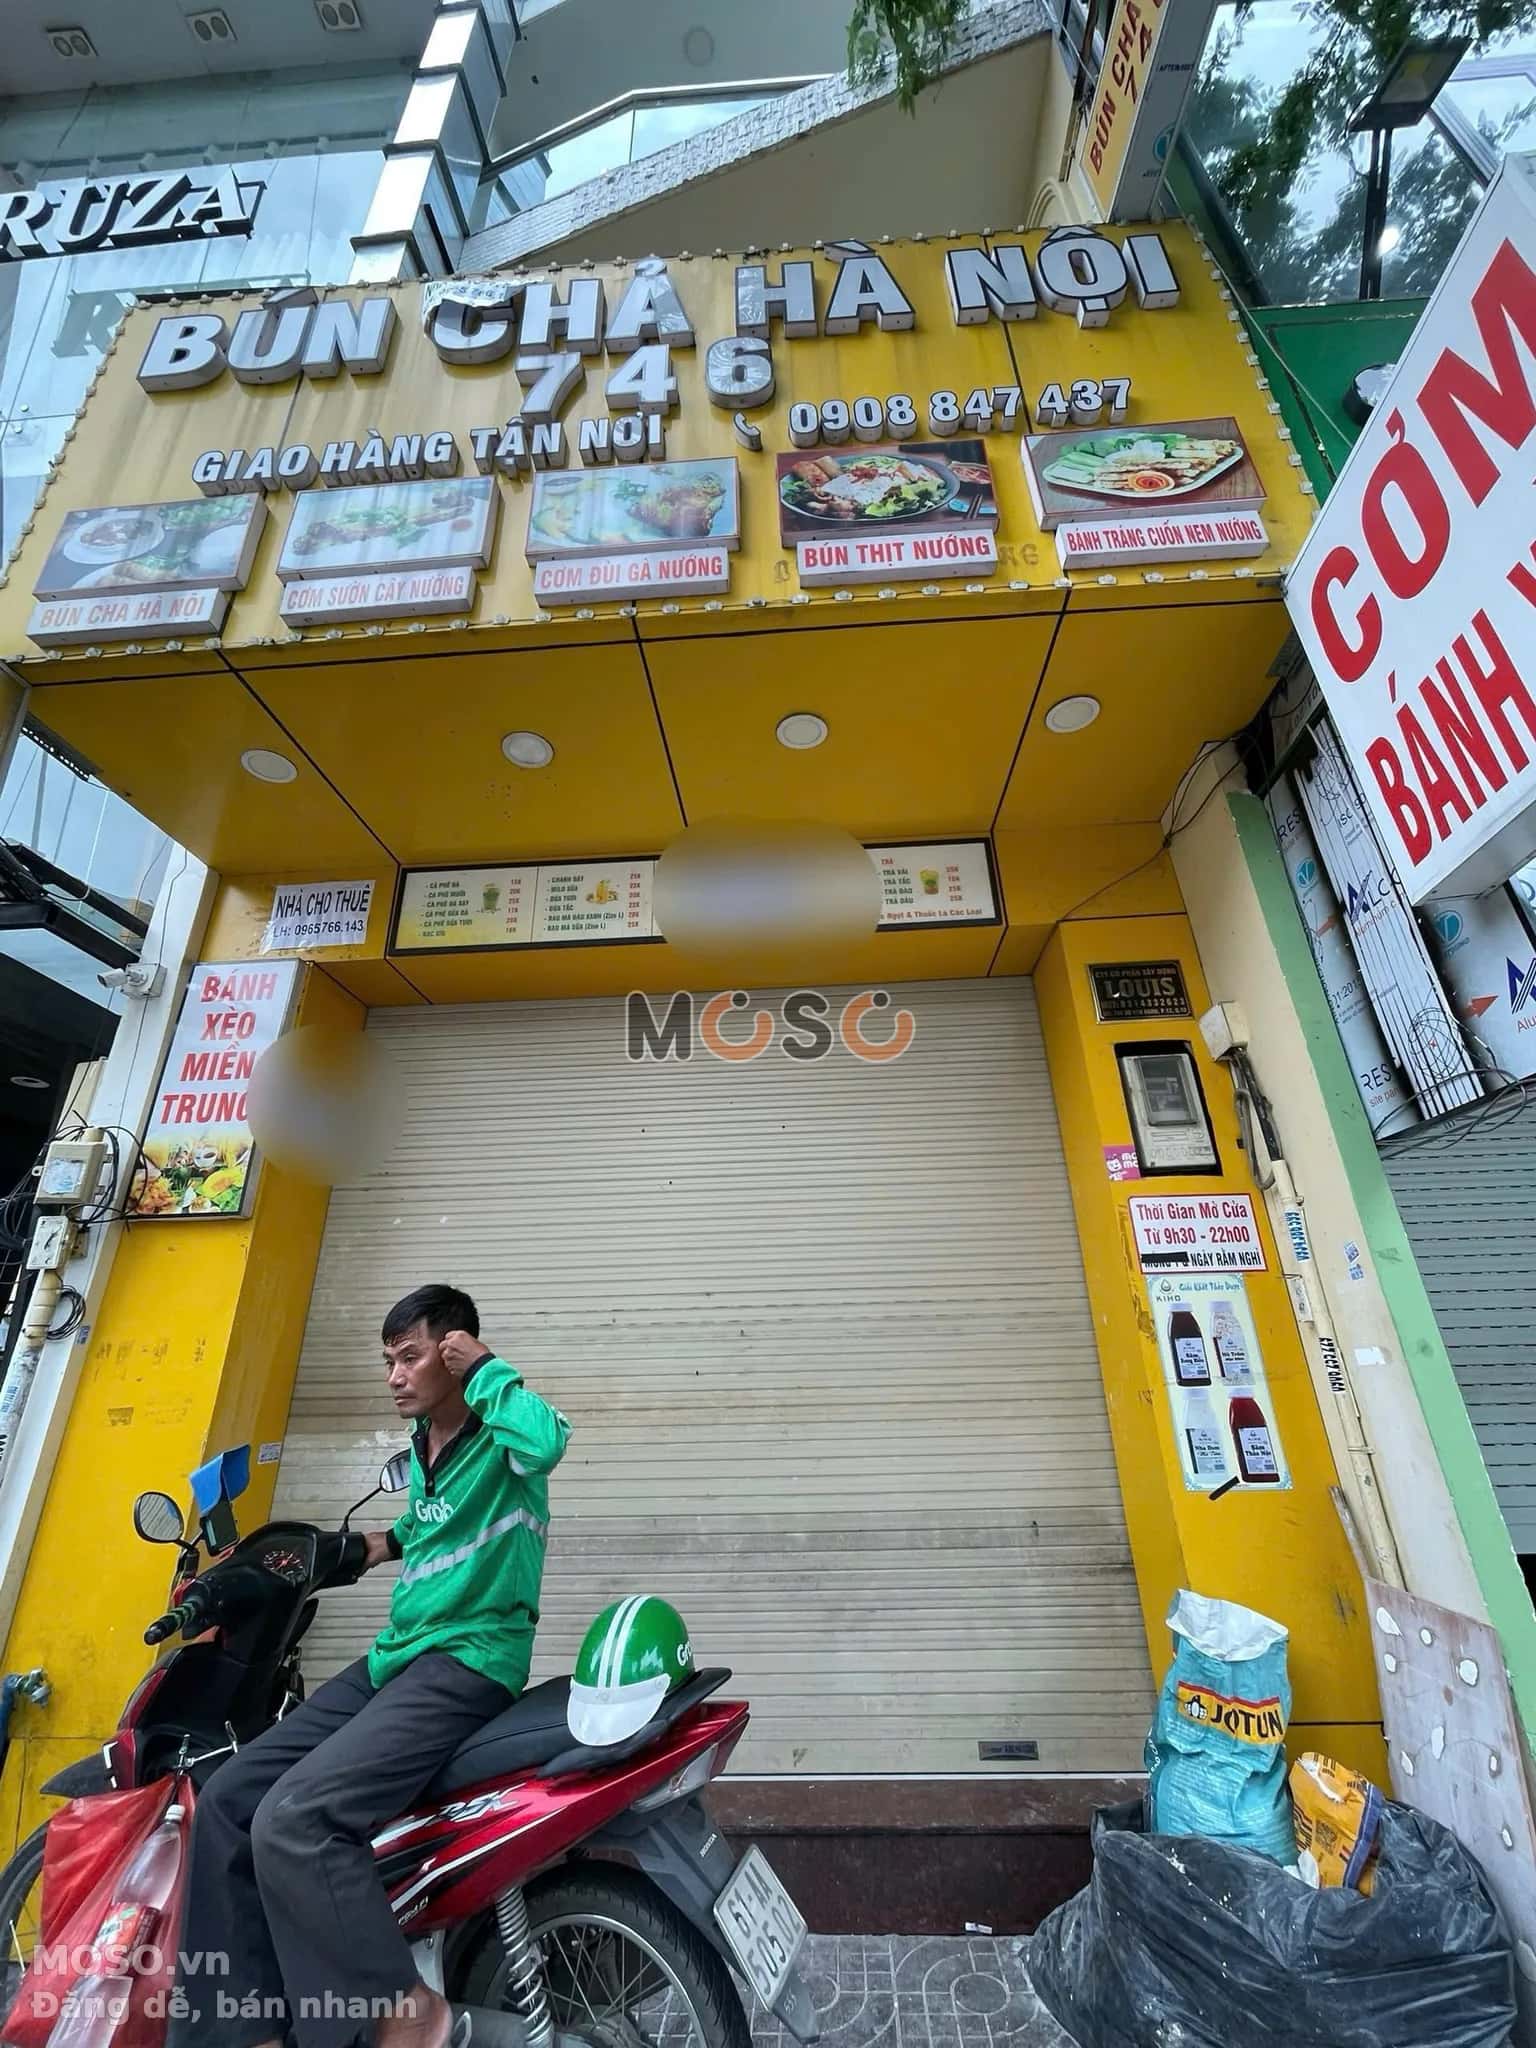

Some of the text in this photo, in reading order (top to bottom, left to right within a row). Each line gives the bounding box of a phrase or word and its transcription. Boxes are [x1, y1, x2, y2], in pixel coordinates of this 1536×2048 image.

[137, 225, 1181, 388] BÚN CHẢ HÀ NỘI
[789, 378, 1131, 442] 0908 847 437
[192, 444, 316, 490] GIAO
[320, 428, 457, 482] HÀNG
[470, 417, 565, 474] TẬN
[803, 541, 849, 568] BÚN
[856, 542, 904, 567] THỊT
[913, 533, 991, 560] NƯỚNG
[1184, 524, 1216, 544] NEM
[1366, 607, 1536, 868] BÁNH
[275, 883, 371, 919] NHÀ CHO THUÊ
[200, 968, 278, 1003] BÁNH
[1104, 976, 1176, 998] LOUIS
[201, 1006, 256, 1041] XÈO
[179, 1041, 256, 1082] MIỀN
[1136, 1200, 1248, 1220] Thời Gian Mở Cửa
[1144, 1226, 1161, 1245] Từ
[1164, 1227, 1196, 1244] 9h30
[1209, 1226, 1250, 1243] 22h00
[415, 1496, 454, 1523] Grab
[1210, 1703, 1284, 1738] JOTUN
